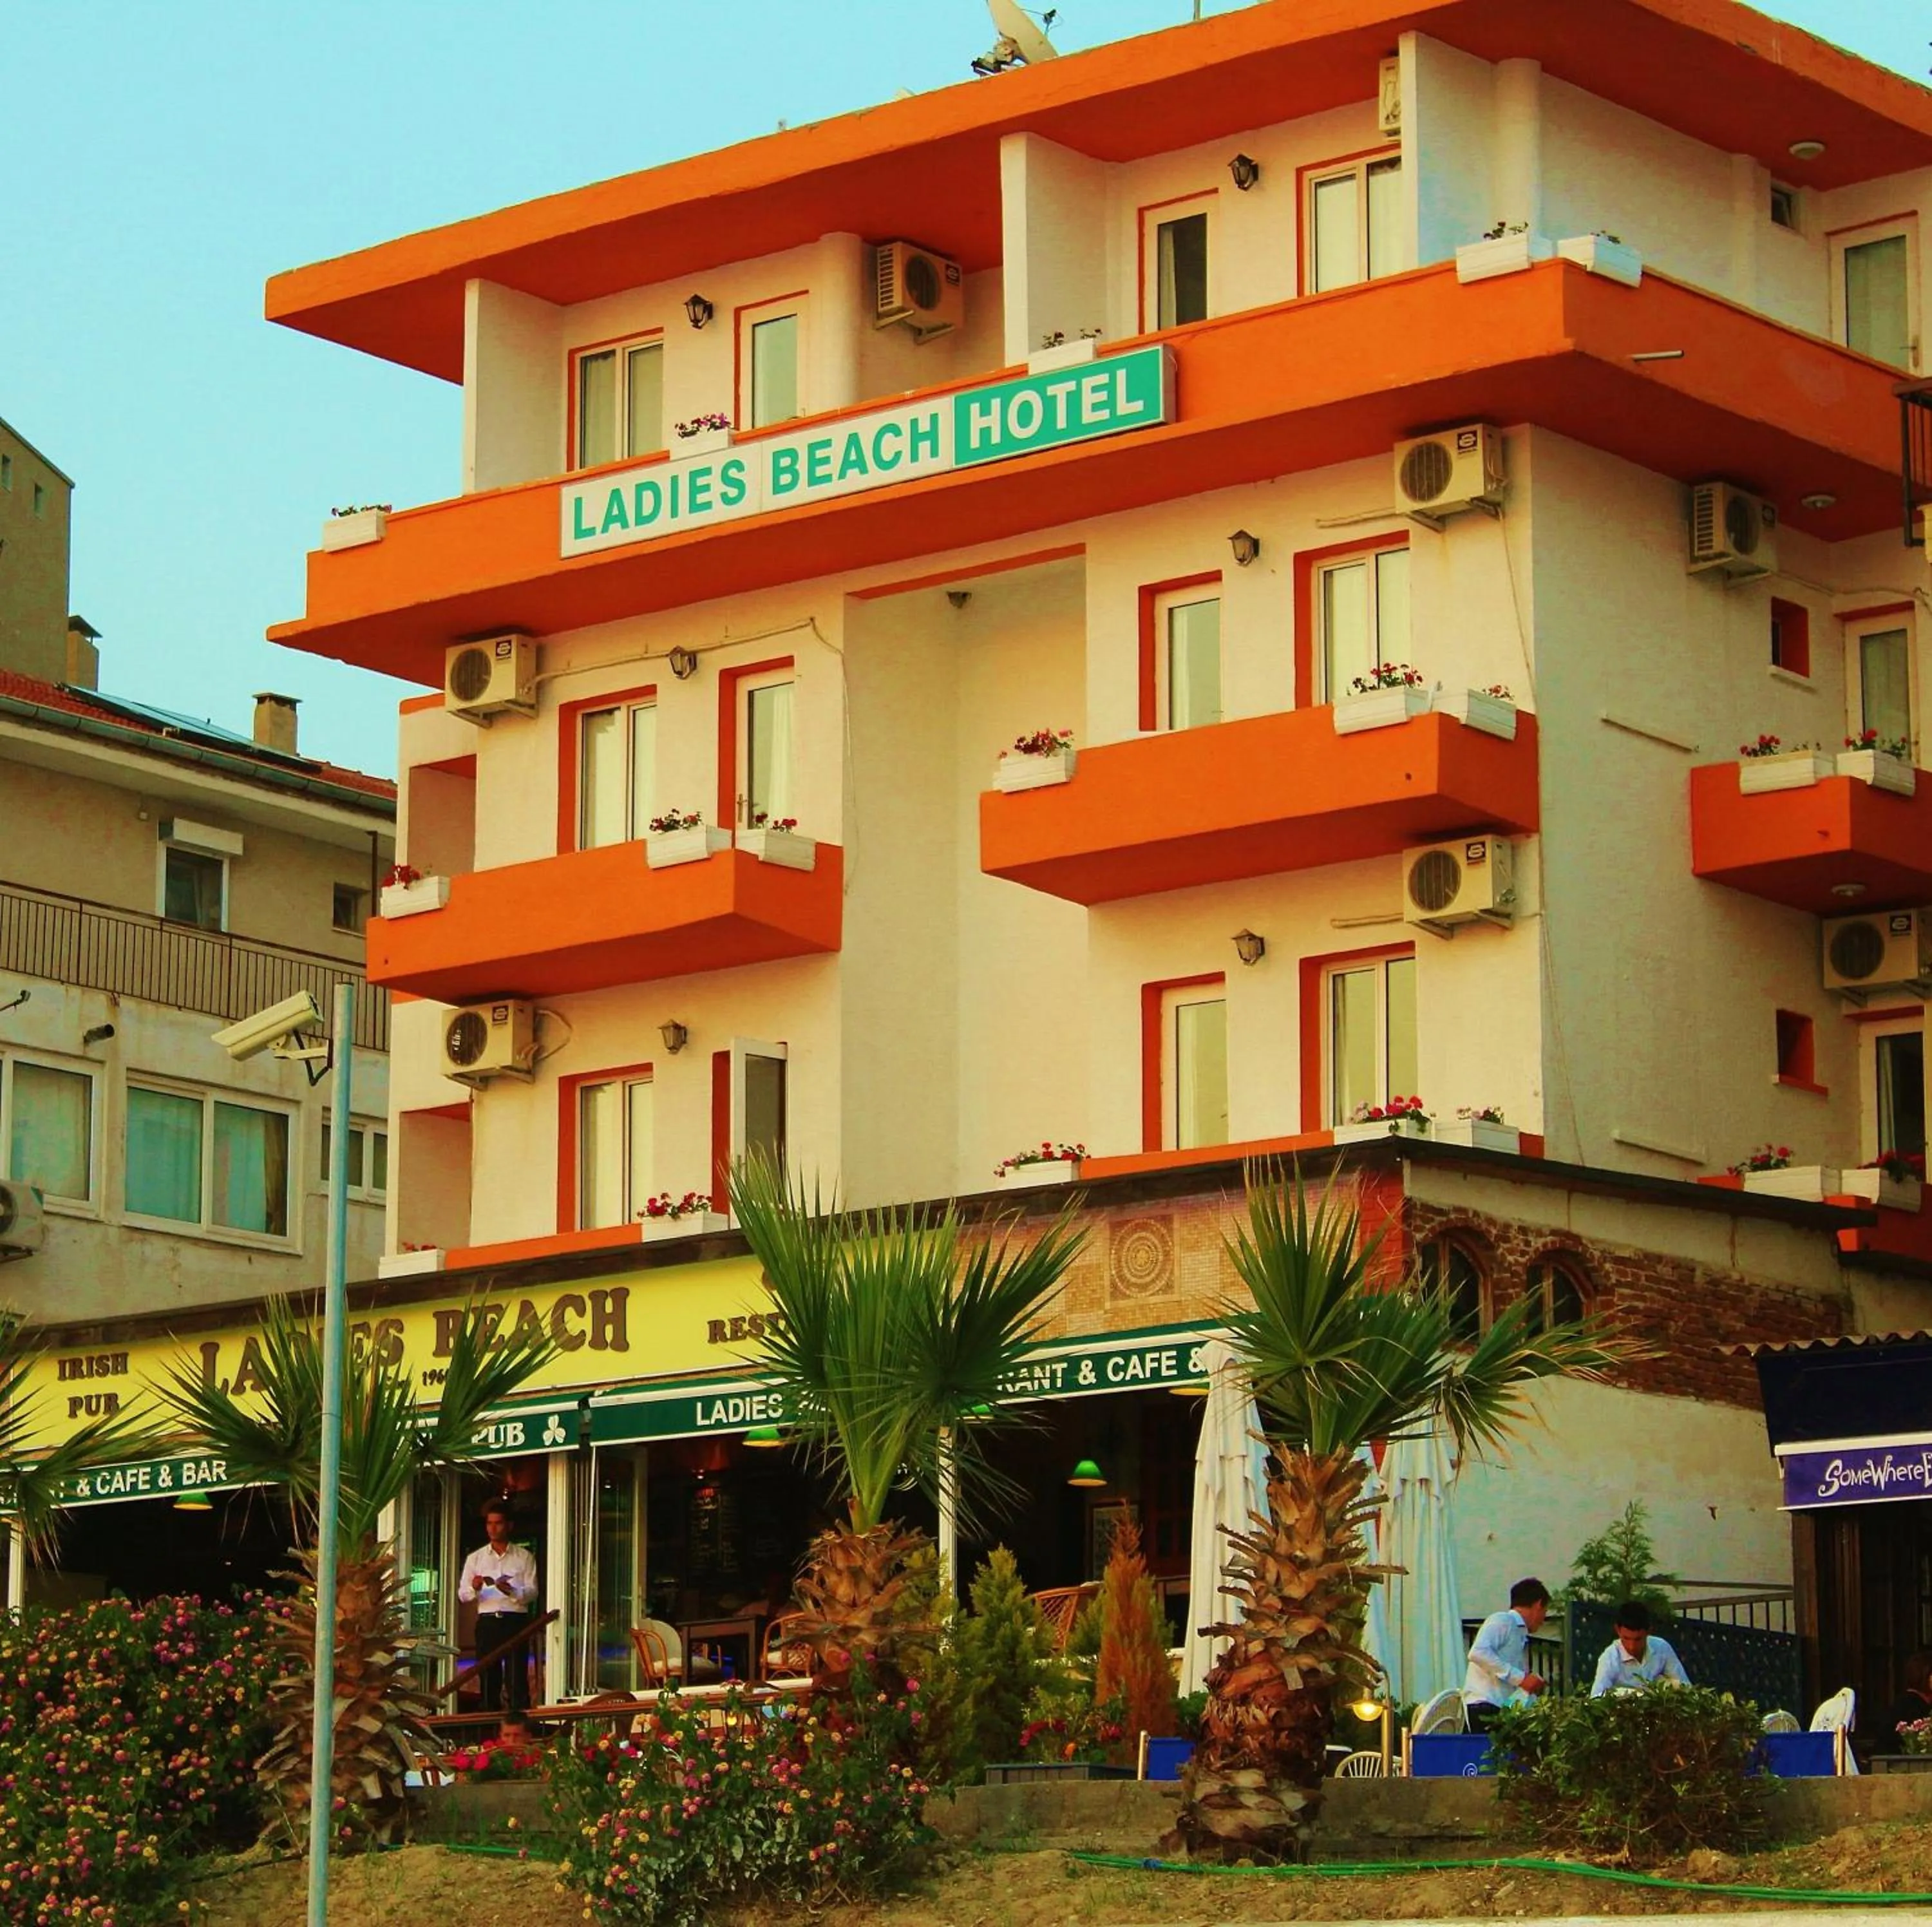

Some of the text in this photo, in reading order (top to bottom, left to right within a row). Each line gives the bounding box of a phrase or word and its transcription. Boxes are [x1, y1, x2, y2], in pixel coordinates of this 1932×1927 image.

[573, 366, 1144, 540] LADIES BEACH HOTEL
[707, 1312, 785, 1343] REST
[57, 1352, 129, 1381] IRISH
[422, 1369, 448, 1387] 196
[1078, 1360, 1097, 1385] &
[1107, 1351, 1178, 1382] CAFE
[68, 1392, 120, 1419] PUB
[696, 1393, 784, 1426] LADIES
[96, 1467, 151, 1495] CAFE
[158, 1464, 173, 1488] &
[182, 1460, 227, 1485] BAR
